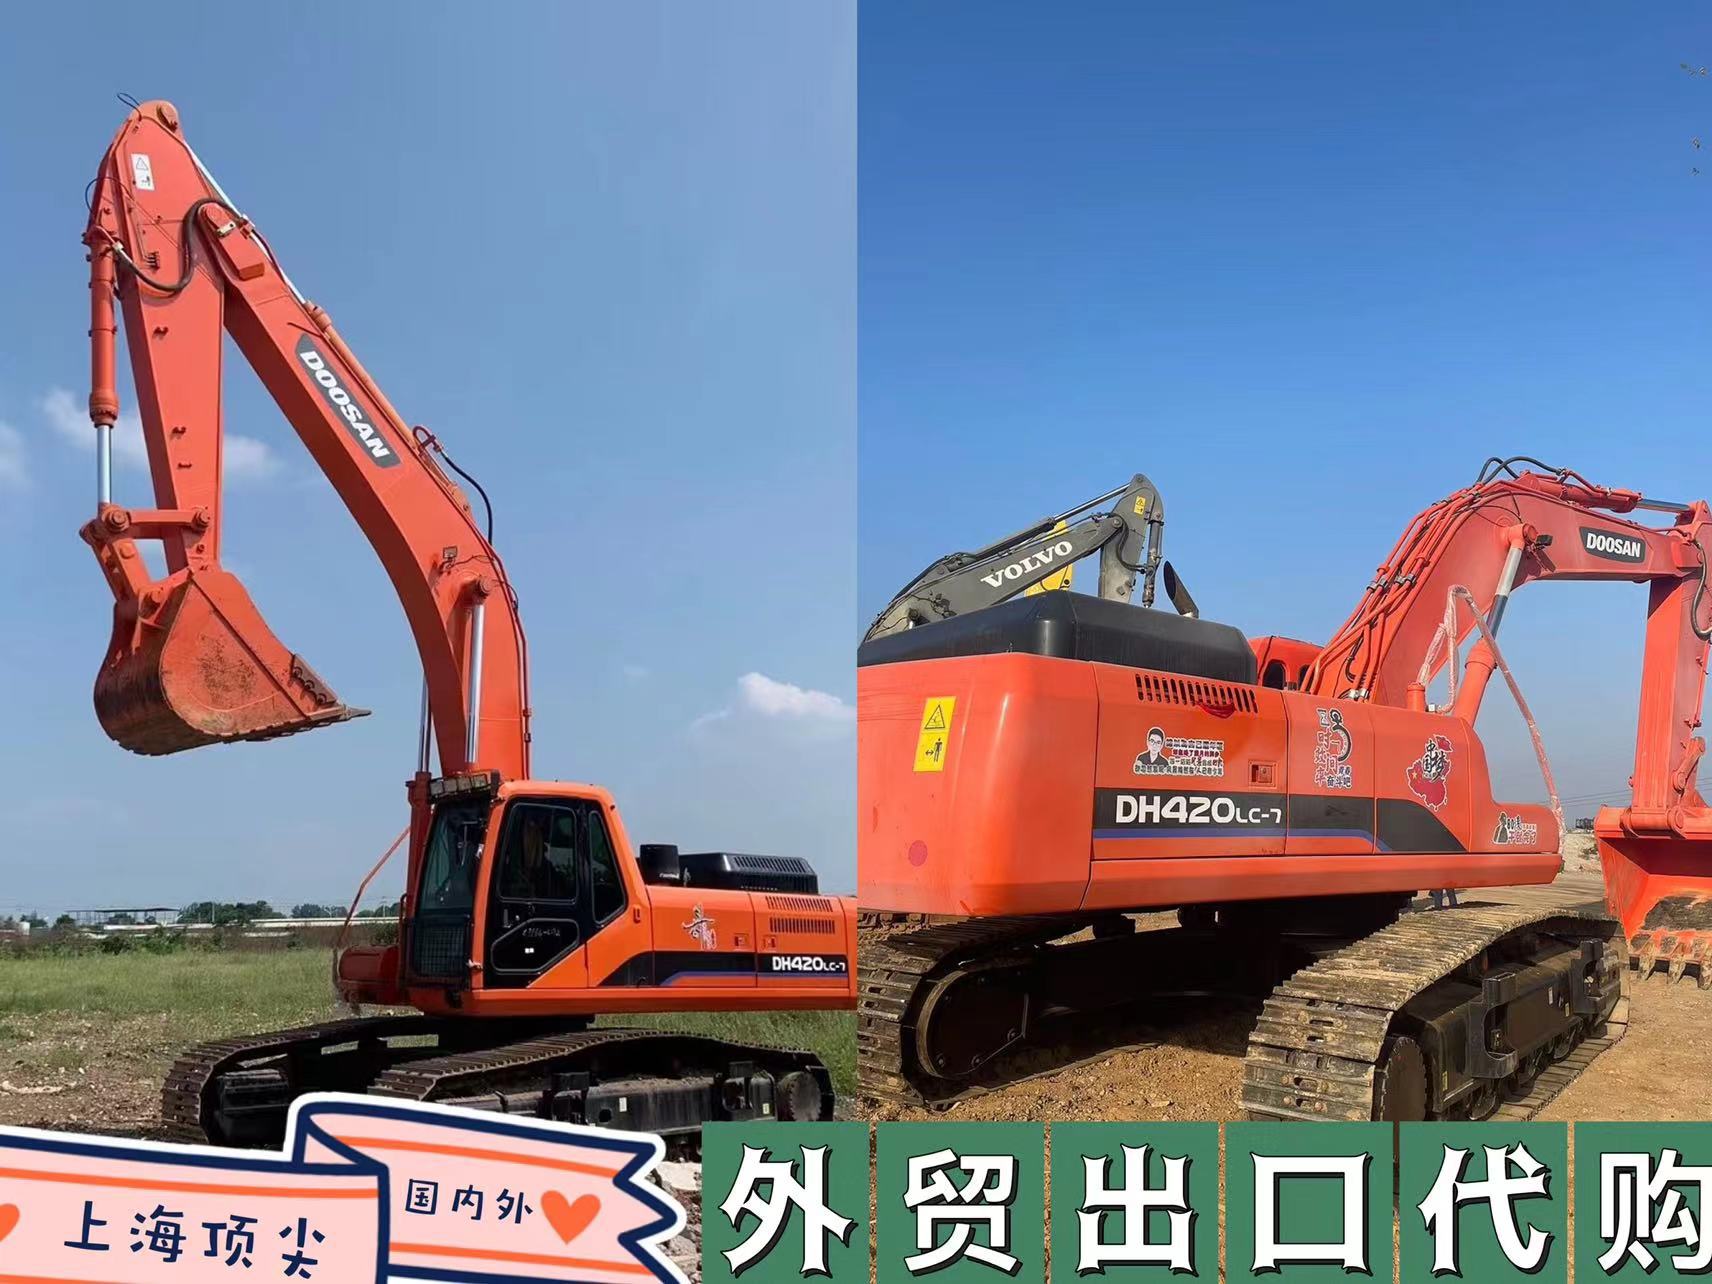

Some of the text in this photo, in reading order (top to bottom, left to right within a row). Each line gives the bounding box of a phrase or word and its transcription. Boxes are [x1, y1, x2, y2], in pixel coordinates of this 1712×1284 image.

[300, 350, 390, 458] DOOSAN
[1586, 532, 1641, 558] DOOSAN
[980, 541, 1073, 588] VOLVO
[1115, 794, 1282, 824] DH420LC-7
[772, 956, 846, 972] DH420LC-7
